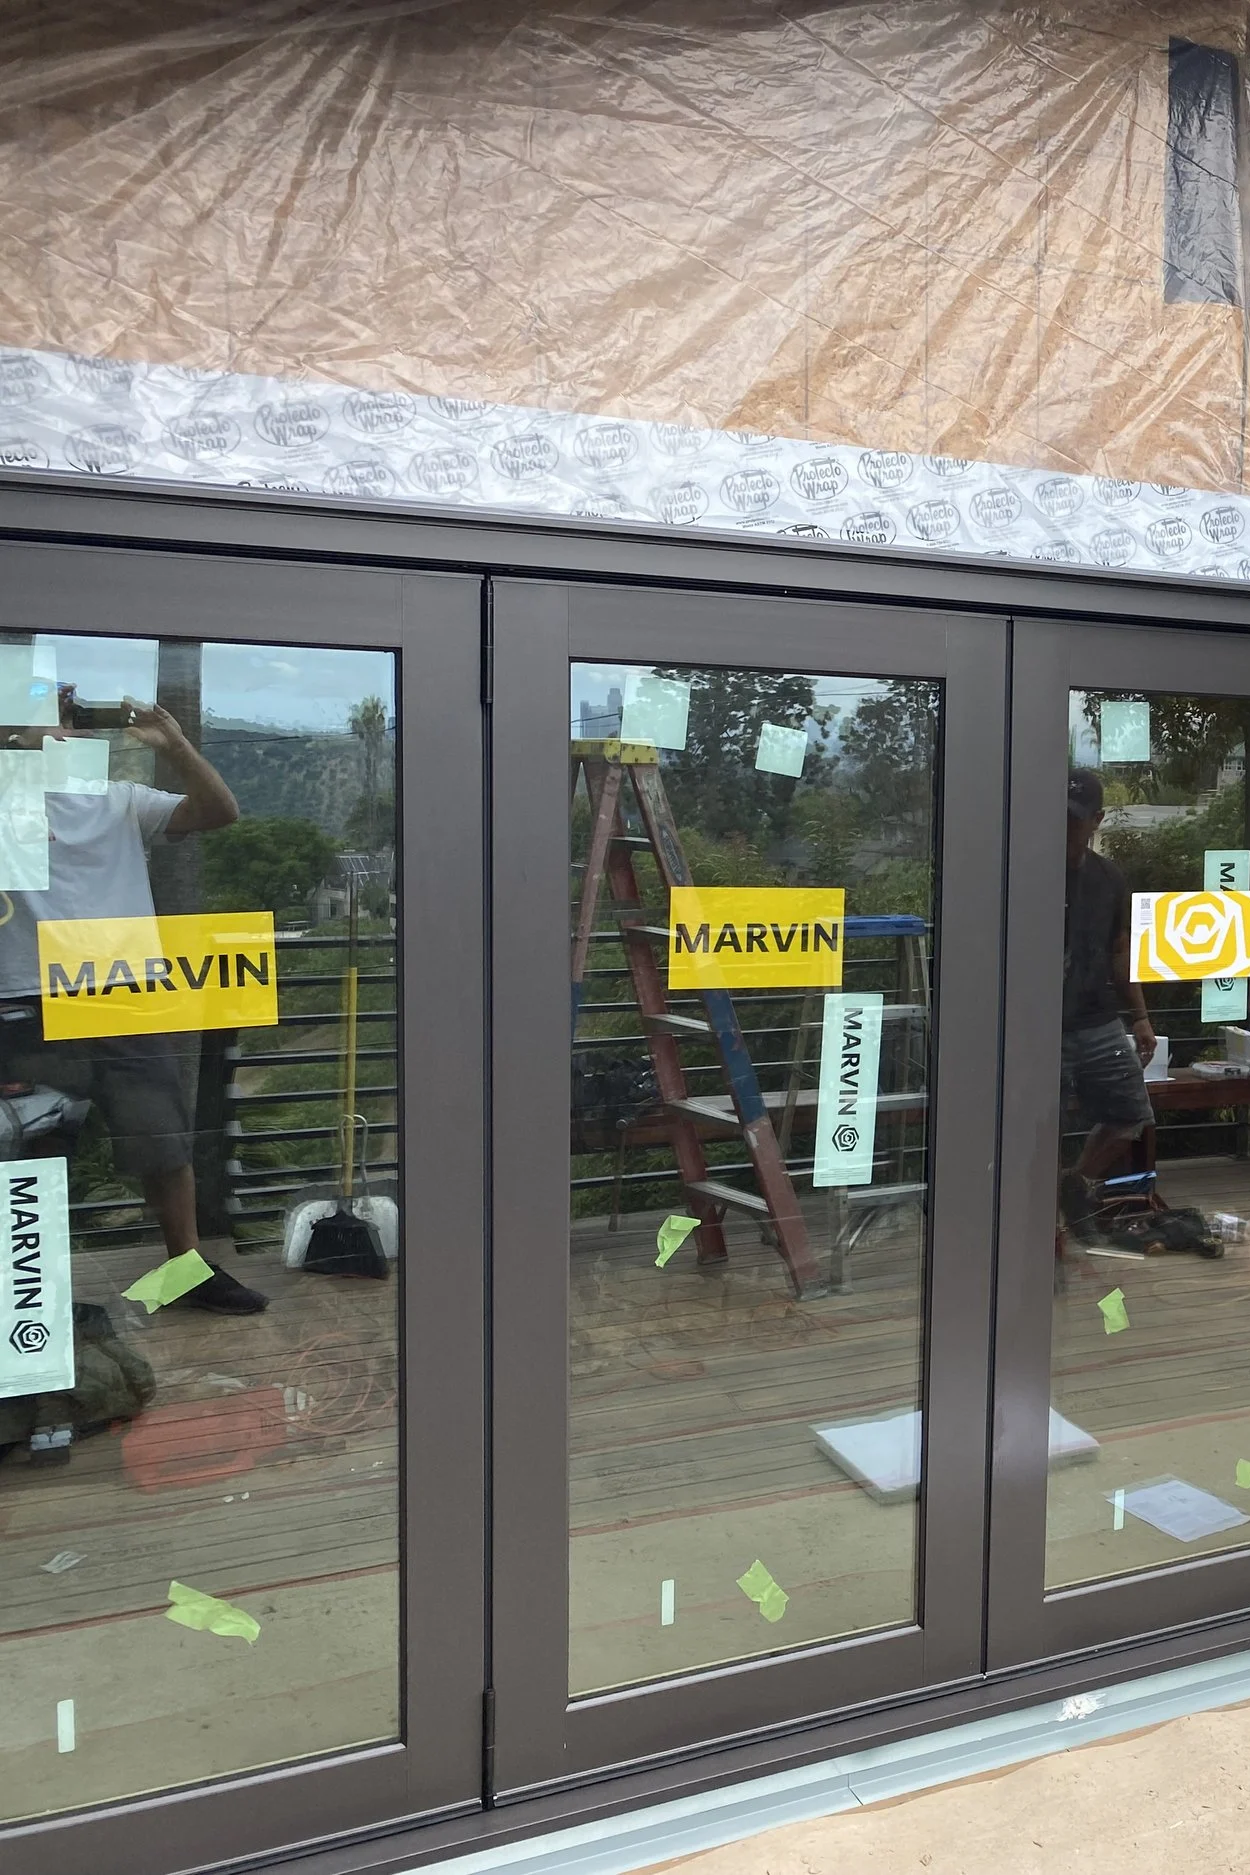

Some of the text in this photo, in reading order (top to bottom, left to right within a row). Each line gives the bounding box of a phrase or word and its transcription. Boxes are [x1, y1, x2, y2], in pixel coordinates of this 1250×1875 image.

[258, 402, 321, 435] Protecto
[359, 412, 403, 433] Wrap
[270, 425, 317, 446] Wrap
[578, 424, 630, 456] Protecto
[495, 435, 550, 468] Protecto
[861, 450, 906, 477] Protecto
[505, 458, 547, 479] Wrap
[794, 459, 841, 488] Protecto
[870, 469, 903, 488] Wrap
[423, 472, 466, 493] Wrap
[723, 471, 773, 501] Protecto
[803, 479, 838, 499] Wrap
[1036, 479, 1077, 507] Protecto
[733, 492, 769, 512] Wrap
[972, 489, 1015, 517] Protecto
[1044, 498, 1075, 517] Wrap
[1103, 488, 1132, 506] Wrap
[662, 504, 698, 524] Wrap
[909, 501, 953, 529] Protecto
[980, 508, 1012, 528] Wrap
[1202, 507, 1239, 534] Protecto
[918, 521, 950, 540] Wrap
[1148, 519, 1186, 546] Protecto
[1209, 526, 1237, 543] Wrap
[1155, 537, 1183, 556] Wrap
[674, 922, 841, 954] MARVIN
[48, 952, 270, 998] MARVIN
[838, 1007, 863, 1117] MARVIN
[9, 1176, 42, 1310] MARVIN
